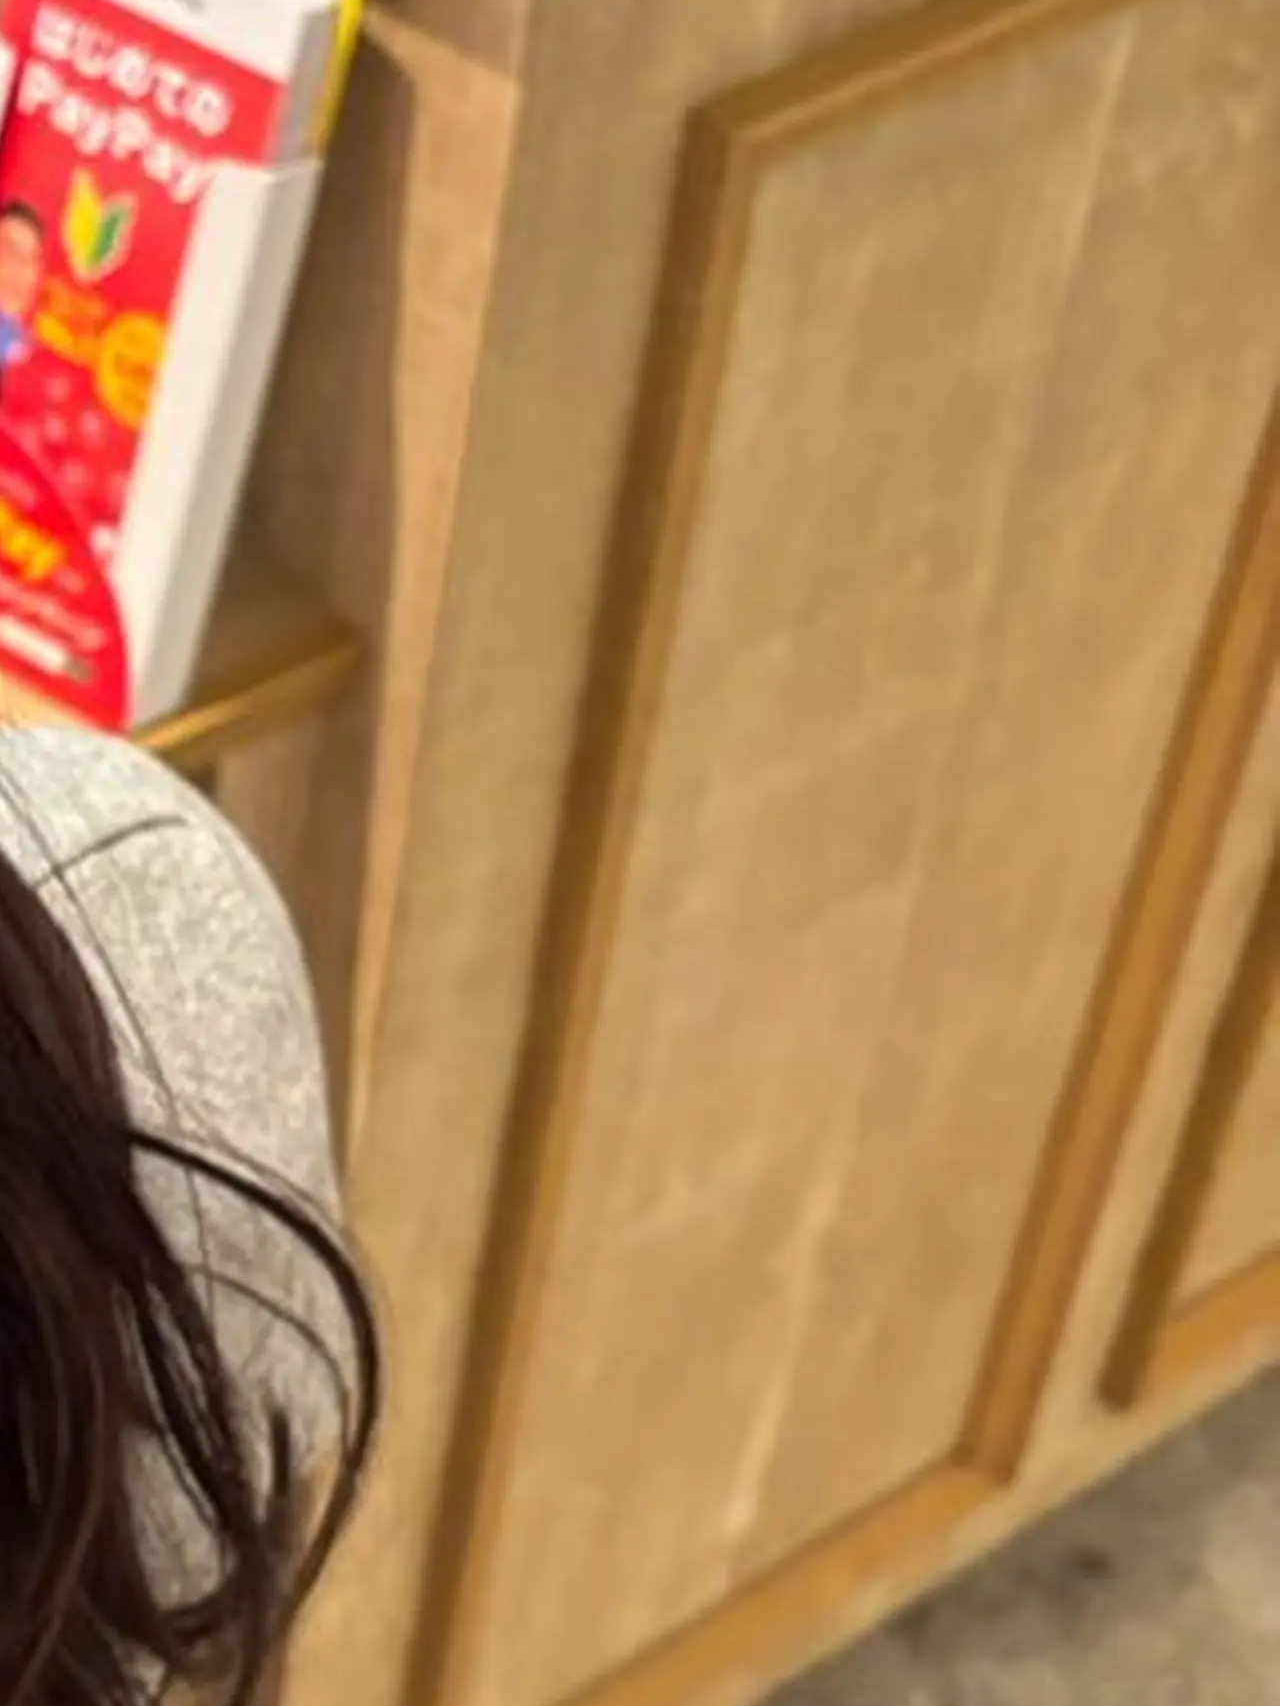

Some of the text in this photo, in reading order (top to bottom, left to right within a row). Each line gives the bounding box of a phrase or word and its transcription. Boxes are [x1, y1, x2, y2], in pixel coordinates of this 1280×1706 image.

[17, 57, 208, 205] PayPay
[31, 0, 233, 138] はじめての
